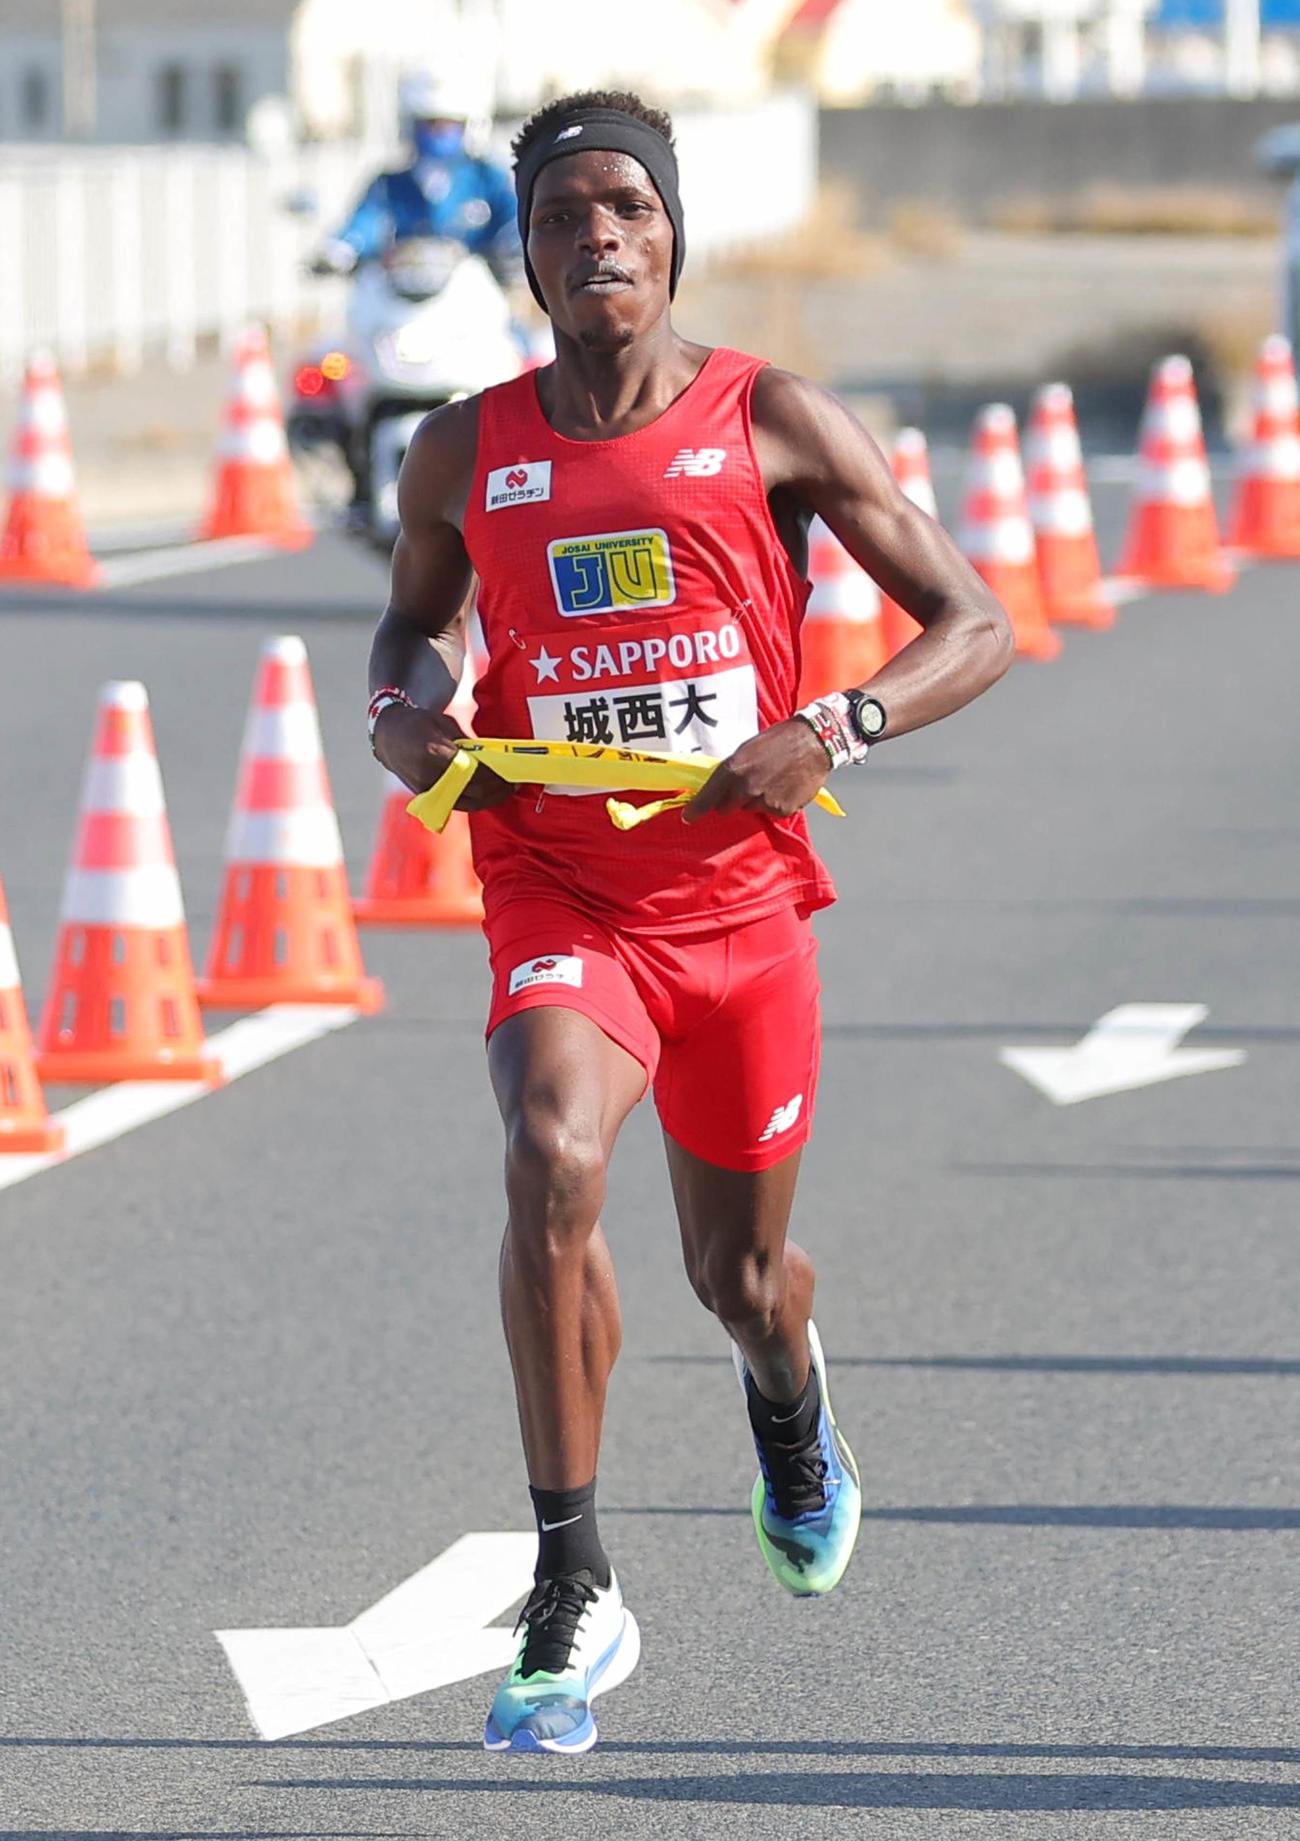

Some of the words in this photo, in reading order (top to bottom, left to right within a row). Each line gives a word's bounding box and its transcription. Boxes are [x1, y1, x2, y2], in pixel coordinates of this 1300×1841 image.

[663, 448, 726, 479] NB
[561, 543, 591, 554] JOSAI
[595, 537, 654, 551] UNIVERSITY
[571, 548, 658, 609] JU
[571, 624, 740, 681] SAPPORO
[563, 683, 719, 745] 城西大
[758, 1093, 803, 1143] NB
